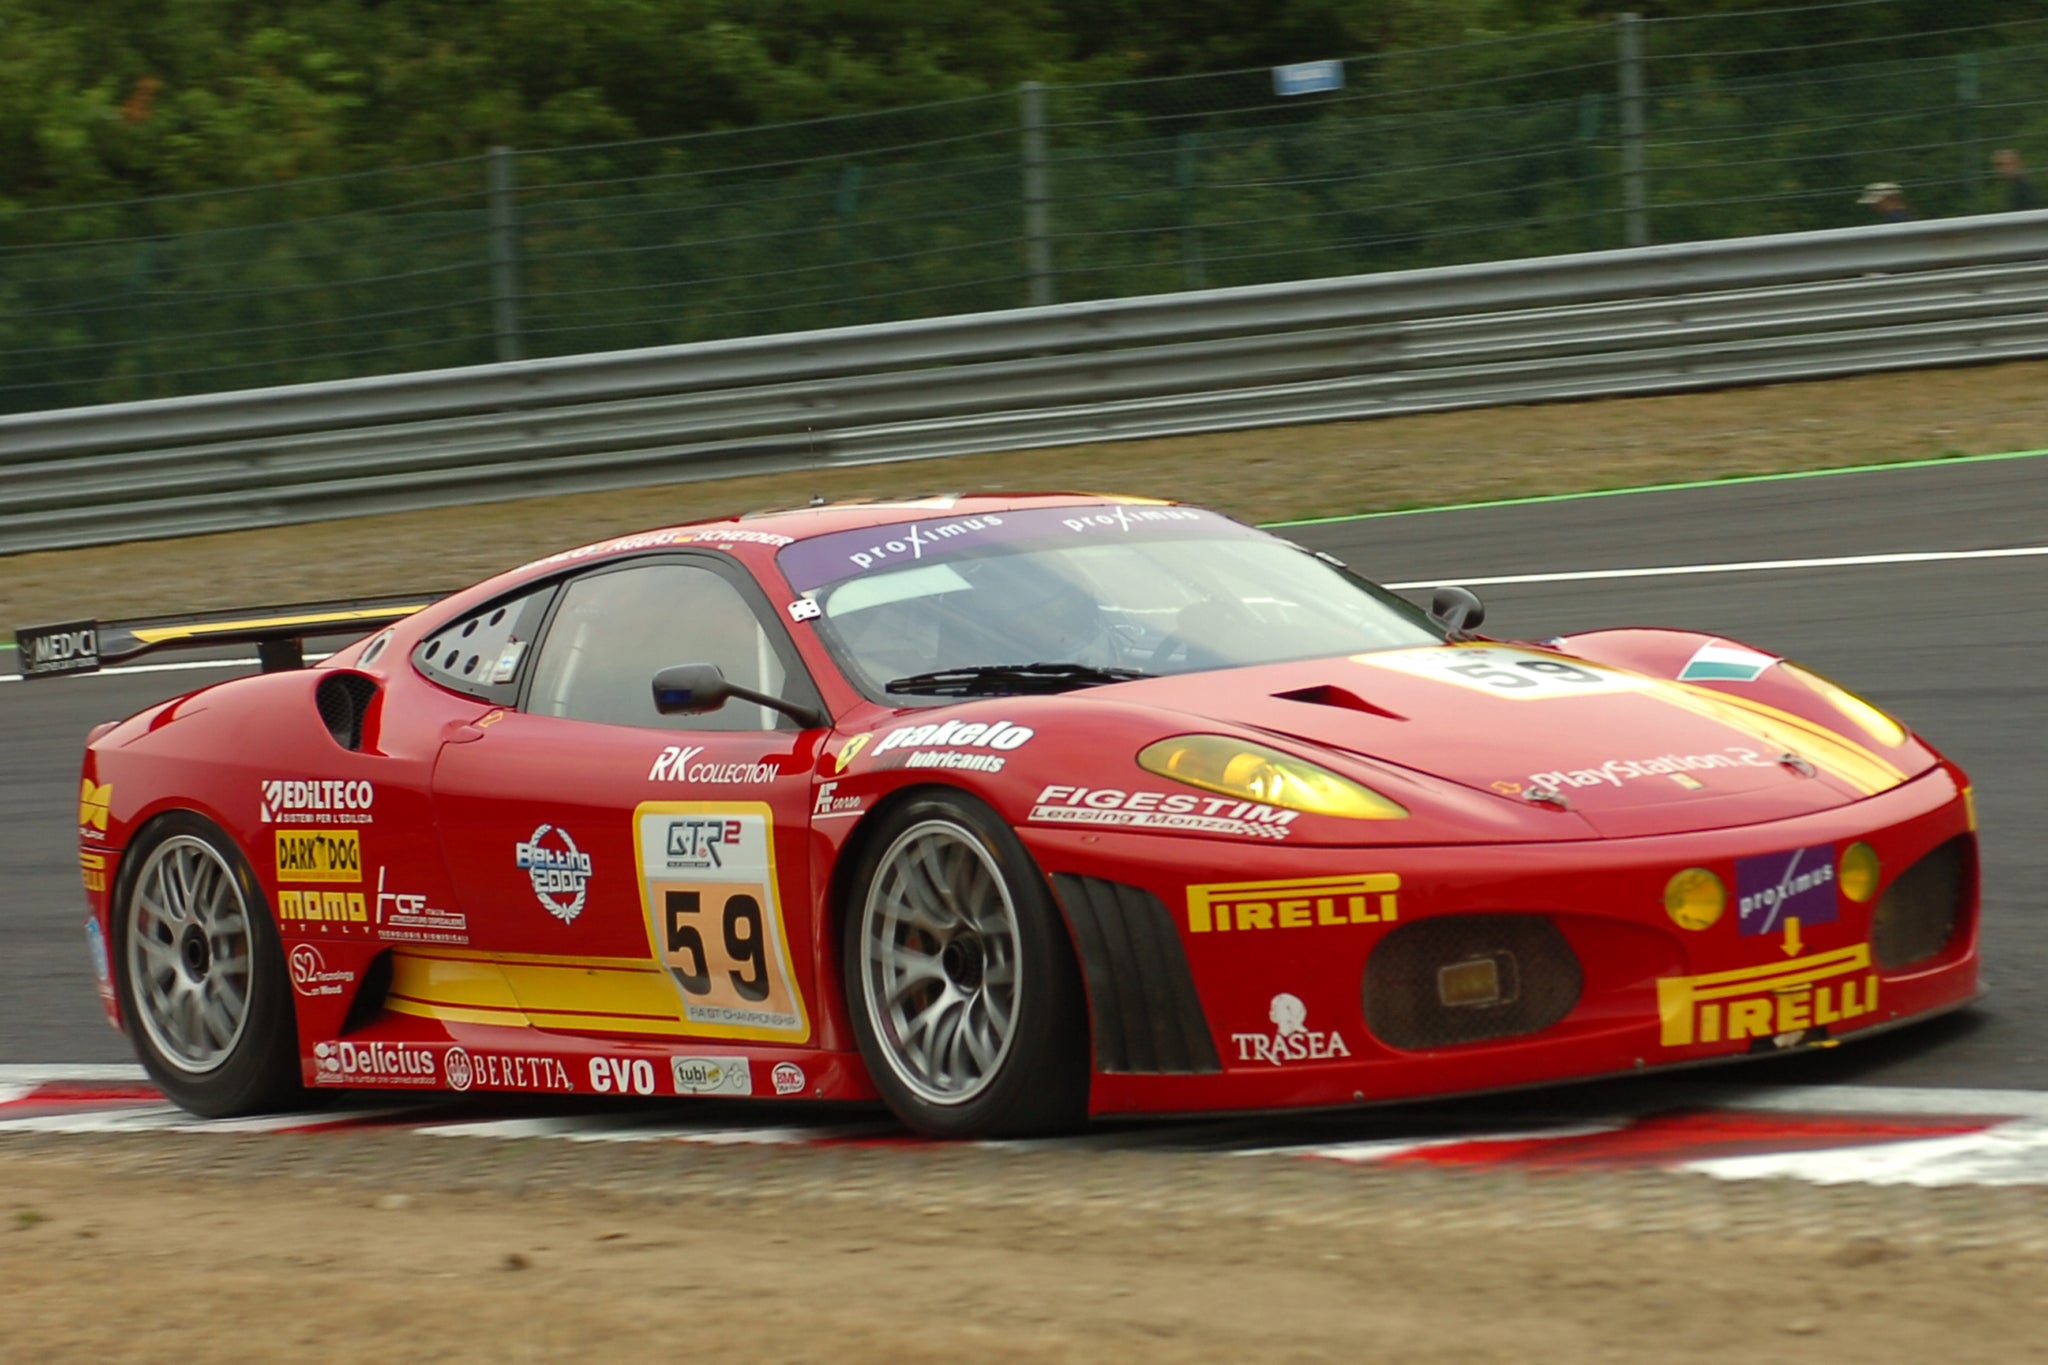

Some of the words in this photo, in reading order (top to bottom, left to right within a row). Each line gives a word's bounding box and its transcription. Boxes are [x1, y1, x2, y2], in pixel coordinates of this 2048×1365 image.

[1062, 507, 1201, 532] proximus
[849, 515, 1003, 568] proximus
[1446, 661, 1604, 689] 59
[870, 720, 1035, 757] pakelo
[688, 763, 779, 783] COLLECTION
[905, 750, 1006, 773] lubricants
[1030, 807, 1134, 825] Leasing
[1145, 813, 1236, 832] Monza
[1036, 785, 1299, 825] FIGESTIM
[279, 838, 317, 870] DARK
[328, 838, 358, 870] DOG
[1186, 872, 1401, 933] PIRELLI
[665, 890, 770, 1002] 59
[1656, 942, 1879, 1047] PIRELLI
[339, 1042, 435, 1074] Delicius
[1231, 1030, 1352, 1067] TRASEA
[473, 1055, 570, 1089] BERETTA
[588, 1056, 655, 1095] evo
[678, 1066, 707, 1081] tubi
